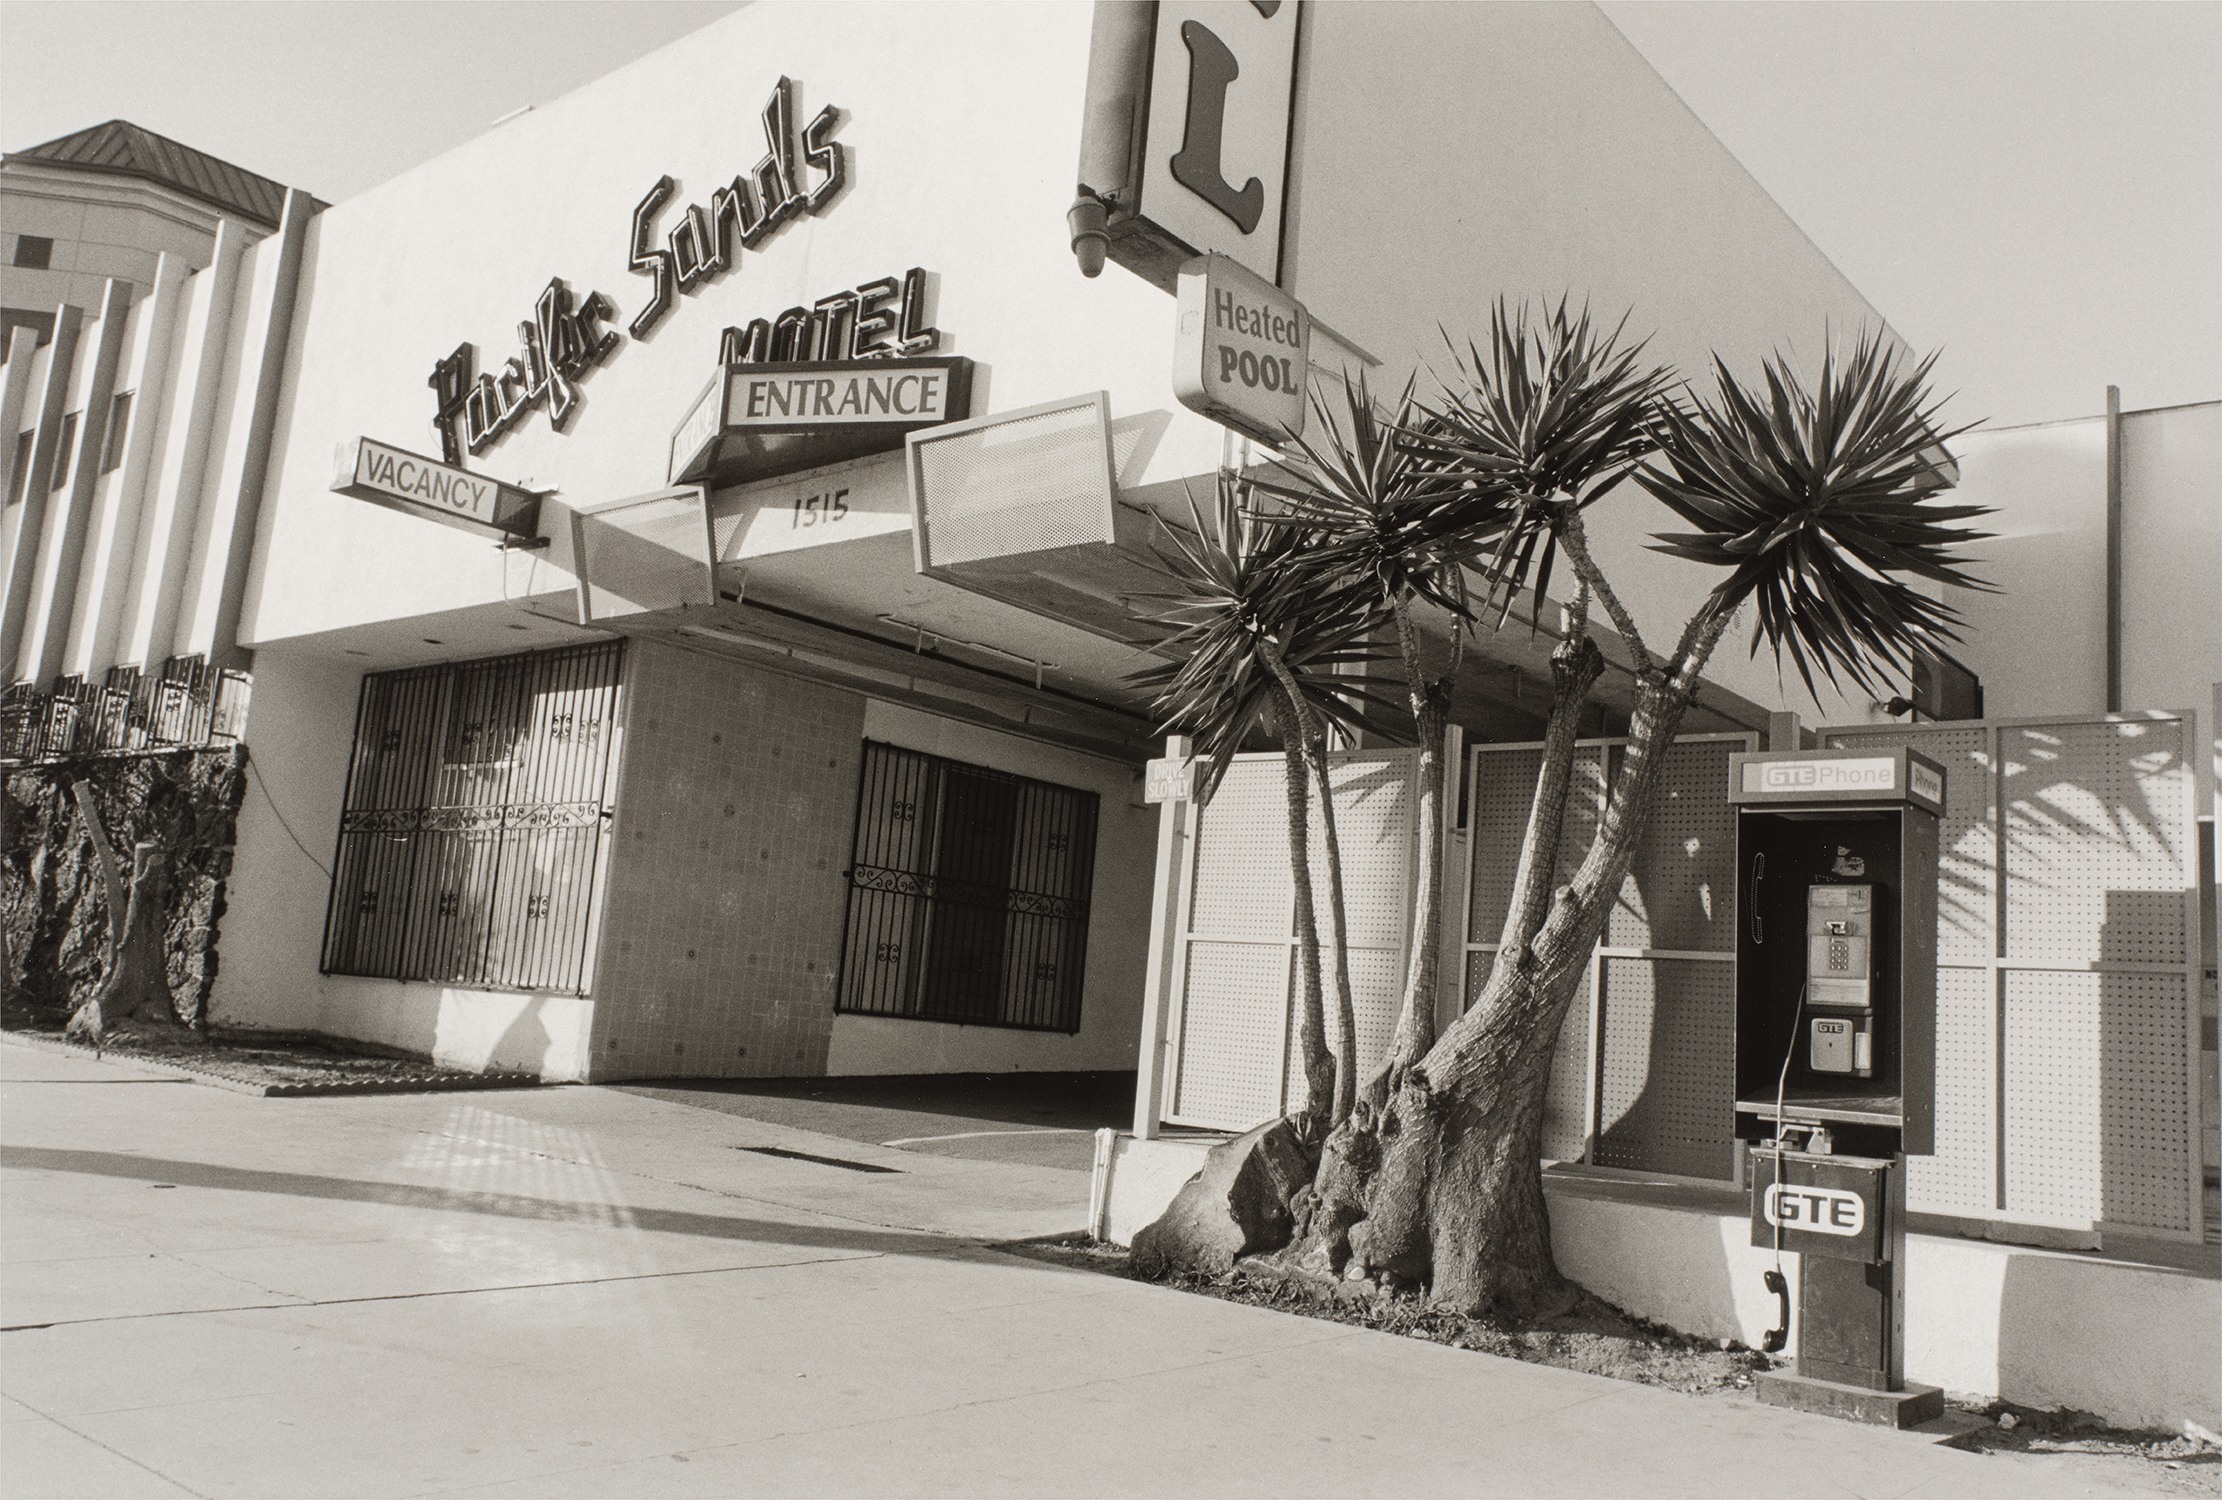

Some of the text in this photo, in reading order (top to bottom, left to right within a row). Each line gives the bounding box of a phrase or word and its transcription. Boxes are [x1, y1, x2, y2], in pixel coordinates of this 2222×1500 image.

[1170, 0, 1281, 235] L
[428, 276, 620, 468] Pacific
[628, 74, 844, 341] Sands
[1214, 287, 1300, 349] Heated
[1218, 344, 1298, 396] POOL
[746, 374, 940, 418] ENTRANCE
[367, 449, 486, 513] VACANCY
[792, 488, 850, 530] 1515
[1148, 779, 1190, 799] SLOWLY
[1154, 761, 1185, 780] DRIVE
[1768, 766, 1892, 786] GTE Phone
[1818, 1022, 1844, 1034] GTE
[1769, 1190, 1857, 1229] GTE
